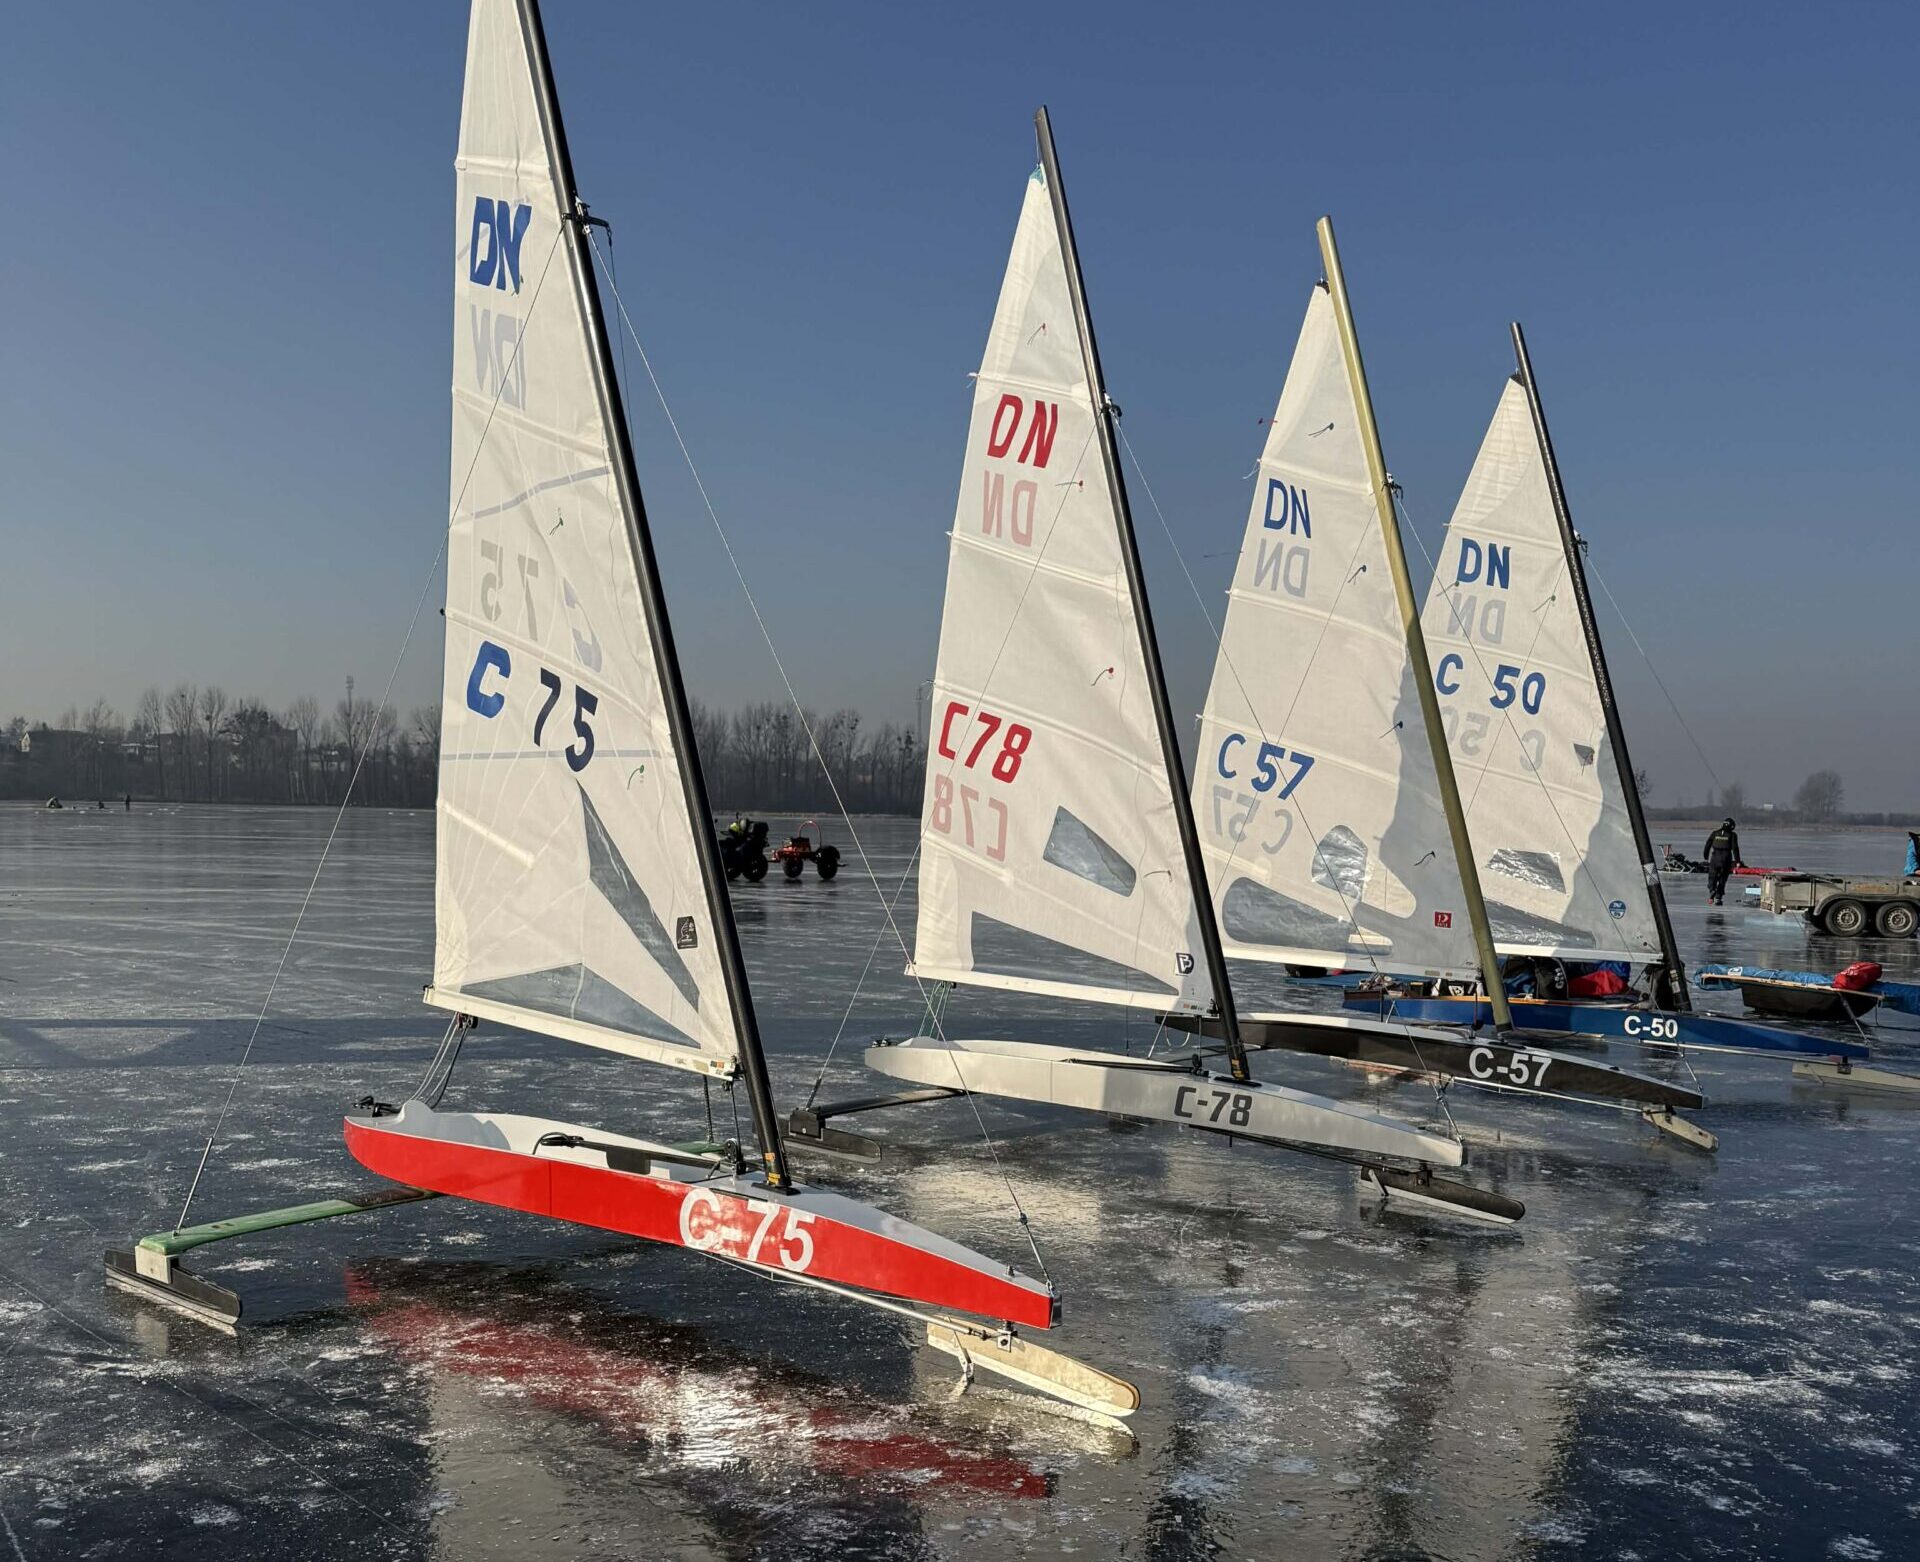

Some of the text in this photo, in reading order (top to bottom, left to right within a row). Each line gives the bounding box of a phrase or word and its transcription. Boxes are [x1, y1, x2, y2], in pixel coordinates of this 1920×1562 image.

[470, 196, 532, 294] DN
[987, 393, 1058, 469] DN
[1264, 478, 1311, 538] DN
[1456, 537, 1511, 590] DN
[466, 640, 598, 772] C 75
[1436, 653, 1546, 715] C 50
[938, 701, 1032, 784] C78
[1218, 733, 1315, 800] C 57
[1624, 1016, 1678, 1038] C-50
[1469, 1048, 1552, 1087] C-57
[1174, 1085, 1253, 1127] C-78
[679, 1188, 816, 1272] C-75
